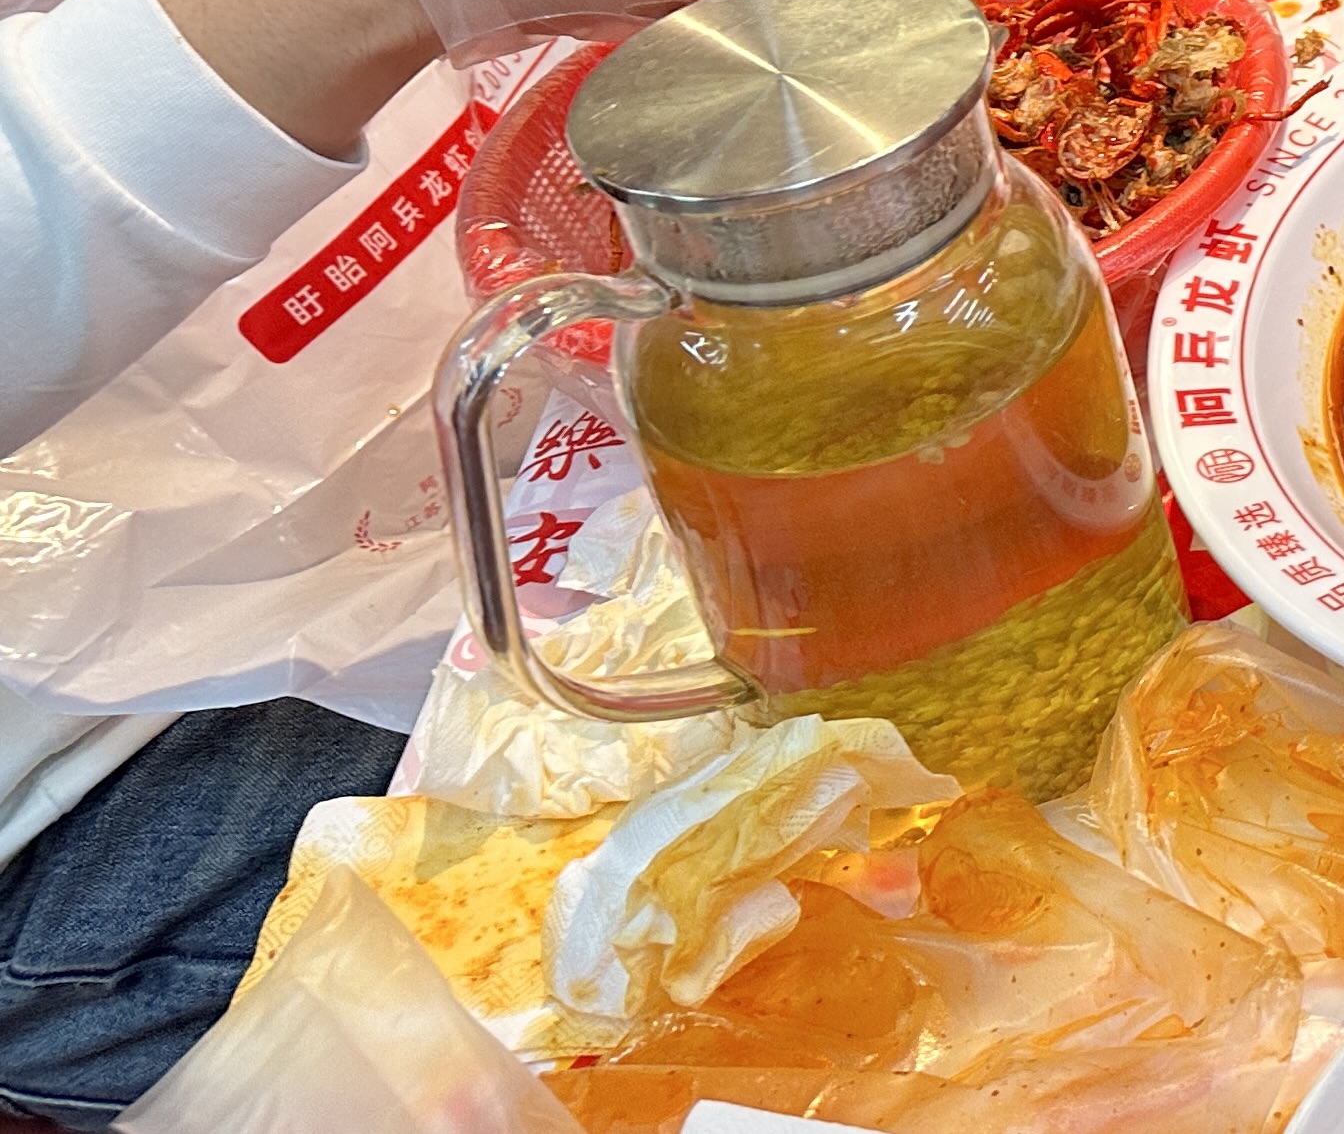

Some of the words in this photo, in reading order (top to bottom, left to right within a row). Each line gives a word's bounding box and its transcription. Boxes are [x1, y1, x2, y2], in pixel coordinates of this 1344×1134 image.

[1246, 111, 1335, 198] SINCE
[1174, 219, 1259, 430] 阿兵龙虾
